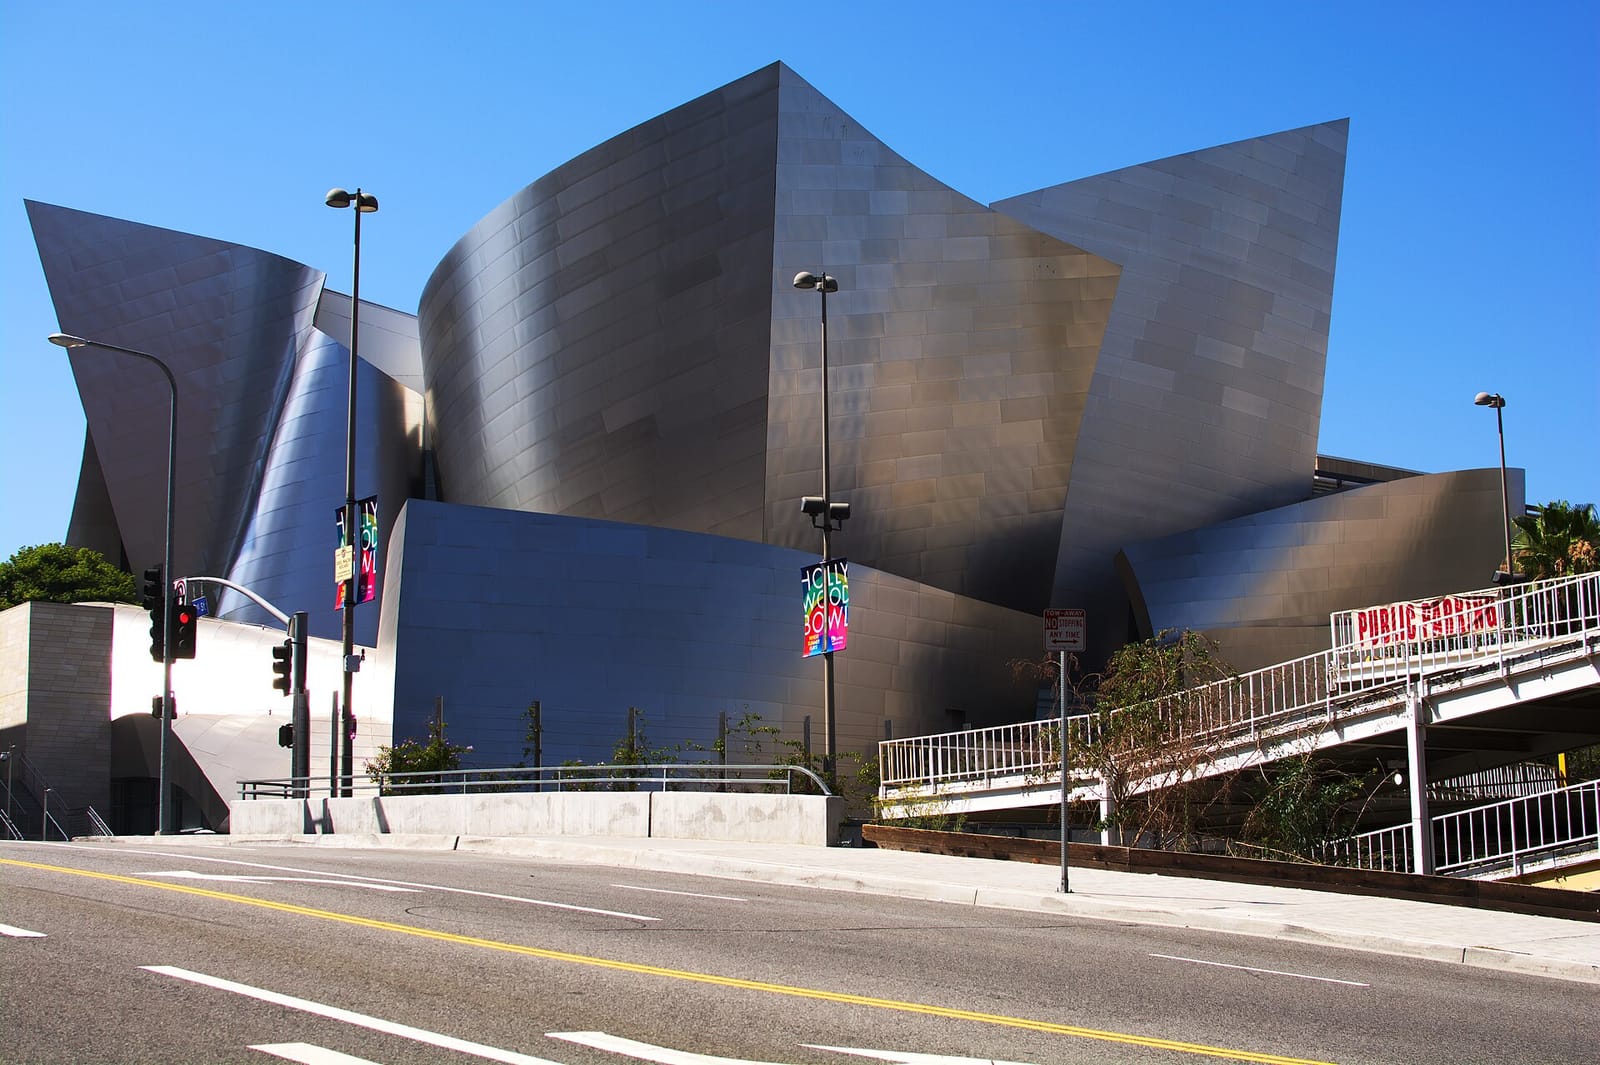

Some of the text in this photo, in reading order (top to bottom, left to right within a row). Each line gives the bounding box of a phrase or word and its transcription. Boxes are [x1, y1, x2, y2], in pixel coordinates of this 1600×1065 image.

[801, 562, 849, 591] HOLLY
[803, 585, 849, 612] WOOD
[804, 605, 849, 635] BOWL
[1046, 617, 1083, 629] NO STOPPING
[1358, 594, 1498, 646] PUBLIC PARKING
